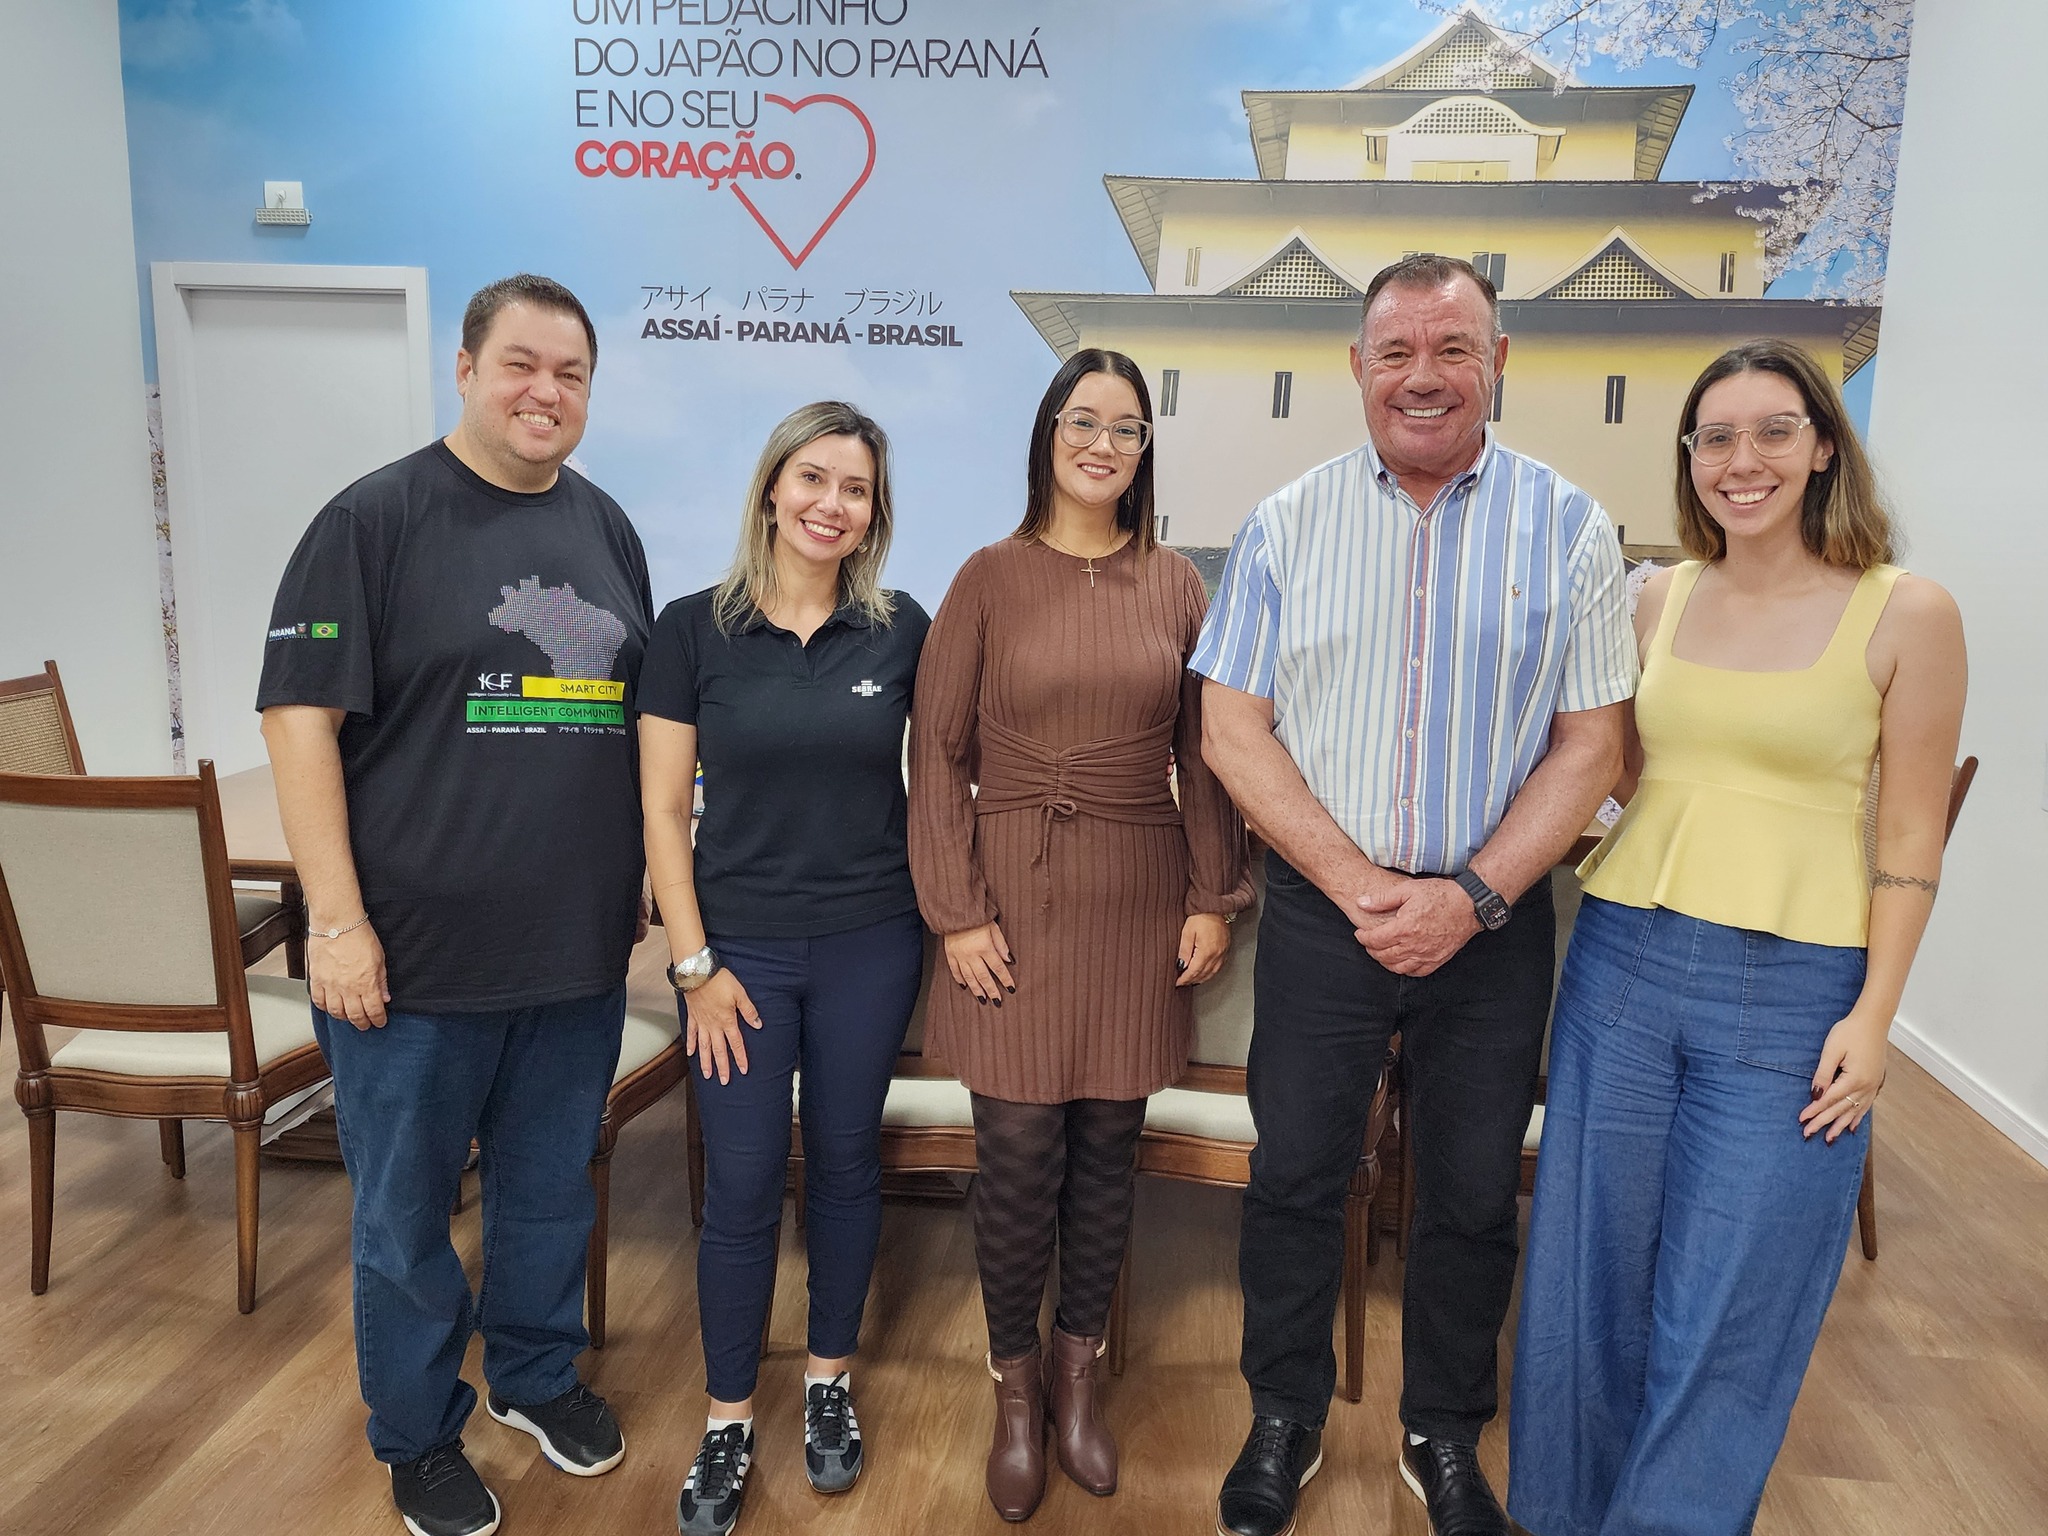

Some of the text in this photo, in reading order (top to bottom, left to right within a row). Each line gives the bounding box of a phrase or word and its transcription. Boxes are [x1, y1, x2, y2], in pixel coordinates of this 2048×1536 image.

[573, 0, 908, 26] UM PEDACINHO
[574, 27, 1049, 78] DO JAPÃO NO PARANÁ
[575, 89, 758, 129] E NO SEU
[574, 130, 802, 190] CORAÇÃO.
[640, 285, 944, 317] アサイ パラナ ブラジル
[640, 314, 721, 341] ASSAÍ
[737, 317, 852, 345] PARANÁ
[867, 323, 963, 347] BRASIL
[560, 683, 617, 695] SMART CITY
[474, 705, 620, 719] INTELLIGENT COMMUNITY
[491, 725, 521, 734] PARANÁ
